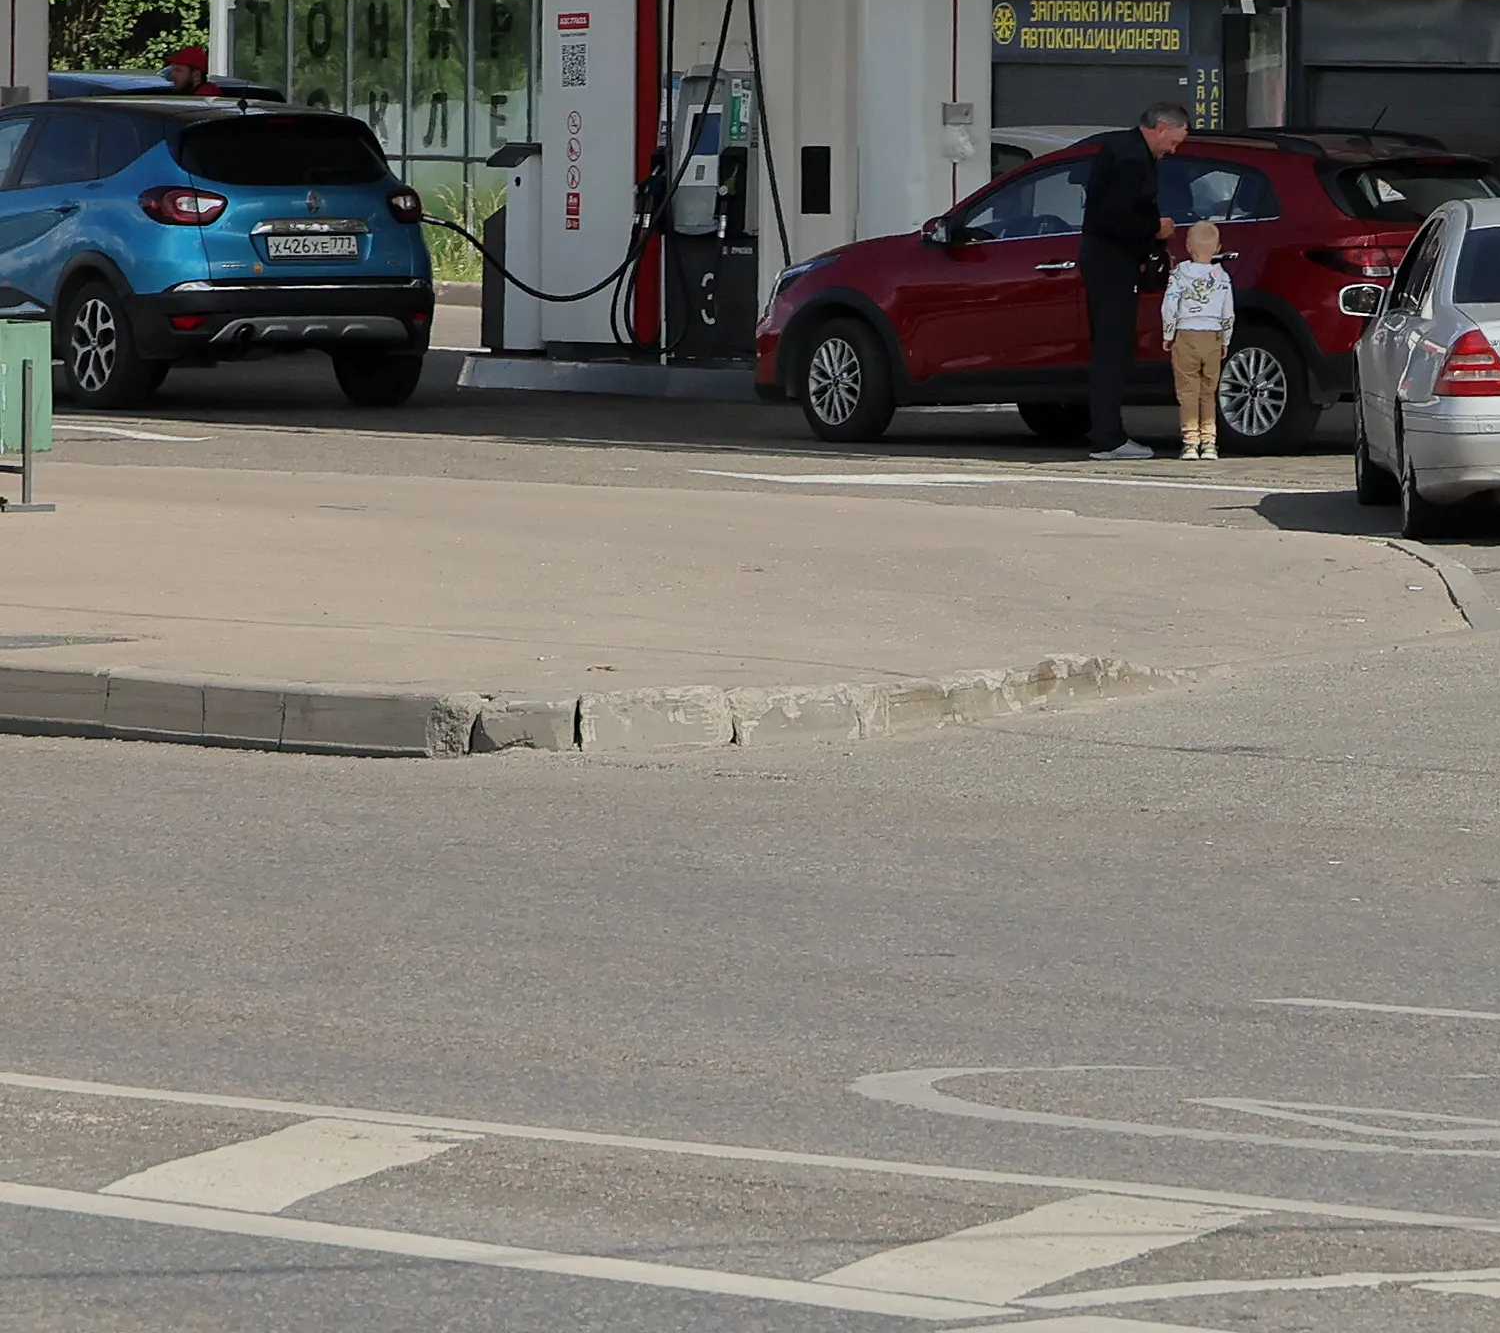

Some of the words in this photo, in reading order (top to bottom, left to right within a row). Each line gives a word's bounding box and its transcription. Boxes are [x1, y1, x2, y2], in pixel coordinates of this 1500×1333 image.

[1030, 0, 1099, 23] ЗАПРАВКА
[1101, 0, 1112, 22] И
[1115, 1, 1172, 23] РЕМОНТ
[1020, 27, 1180, 54] АВТОКОНДИЦИОНЕРОВ
